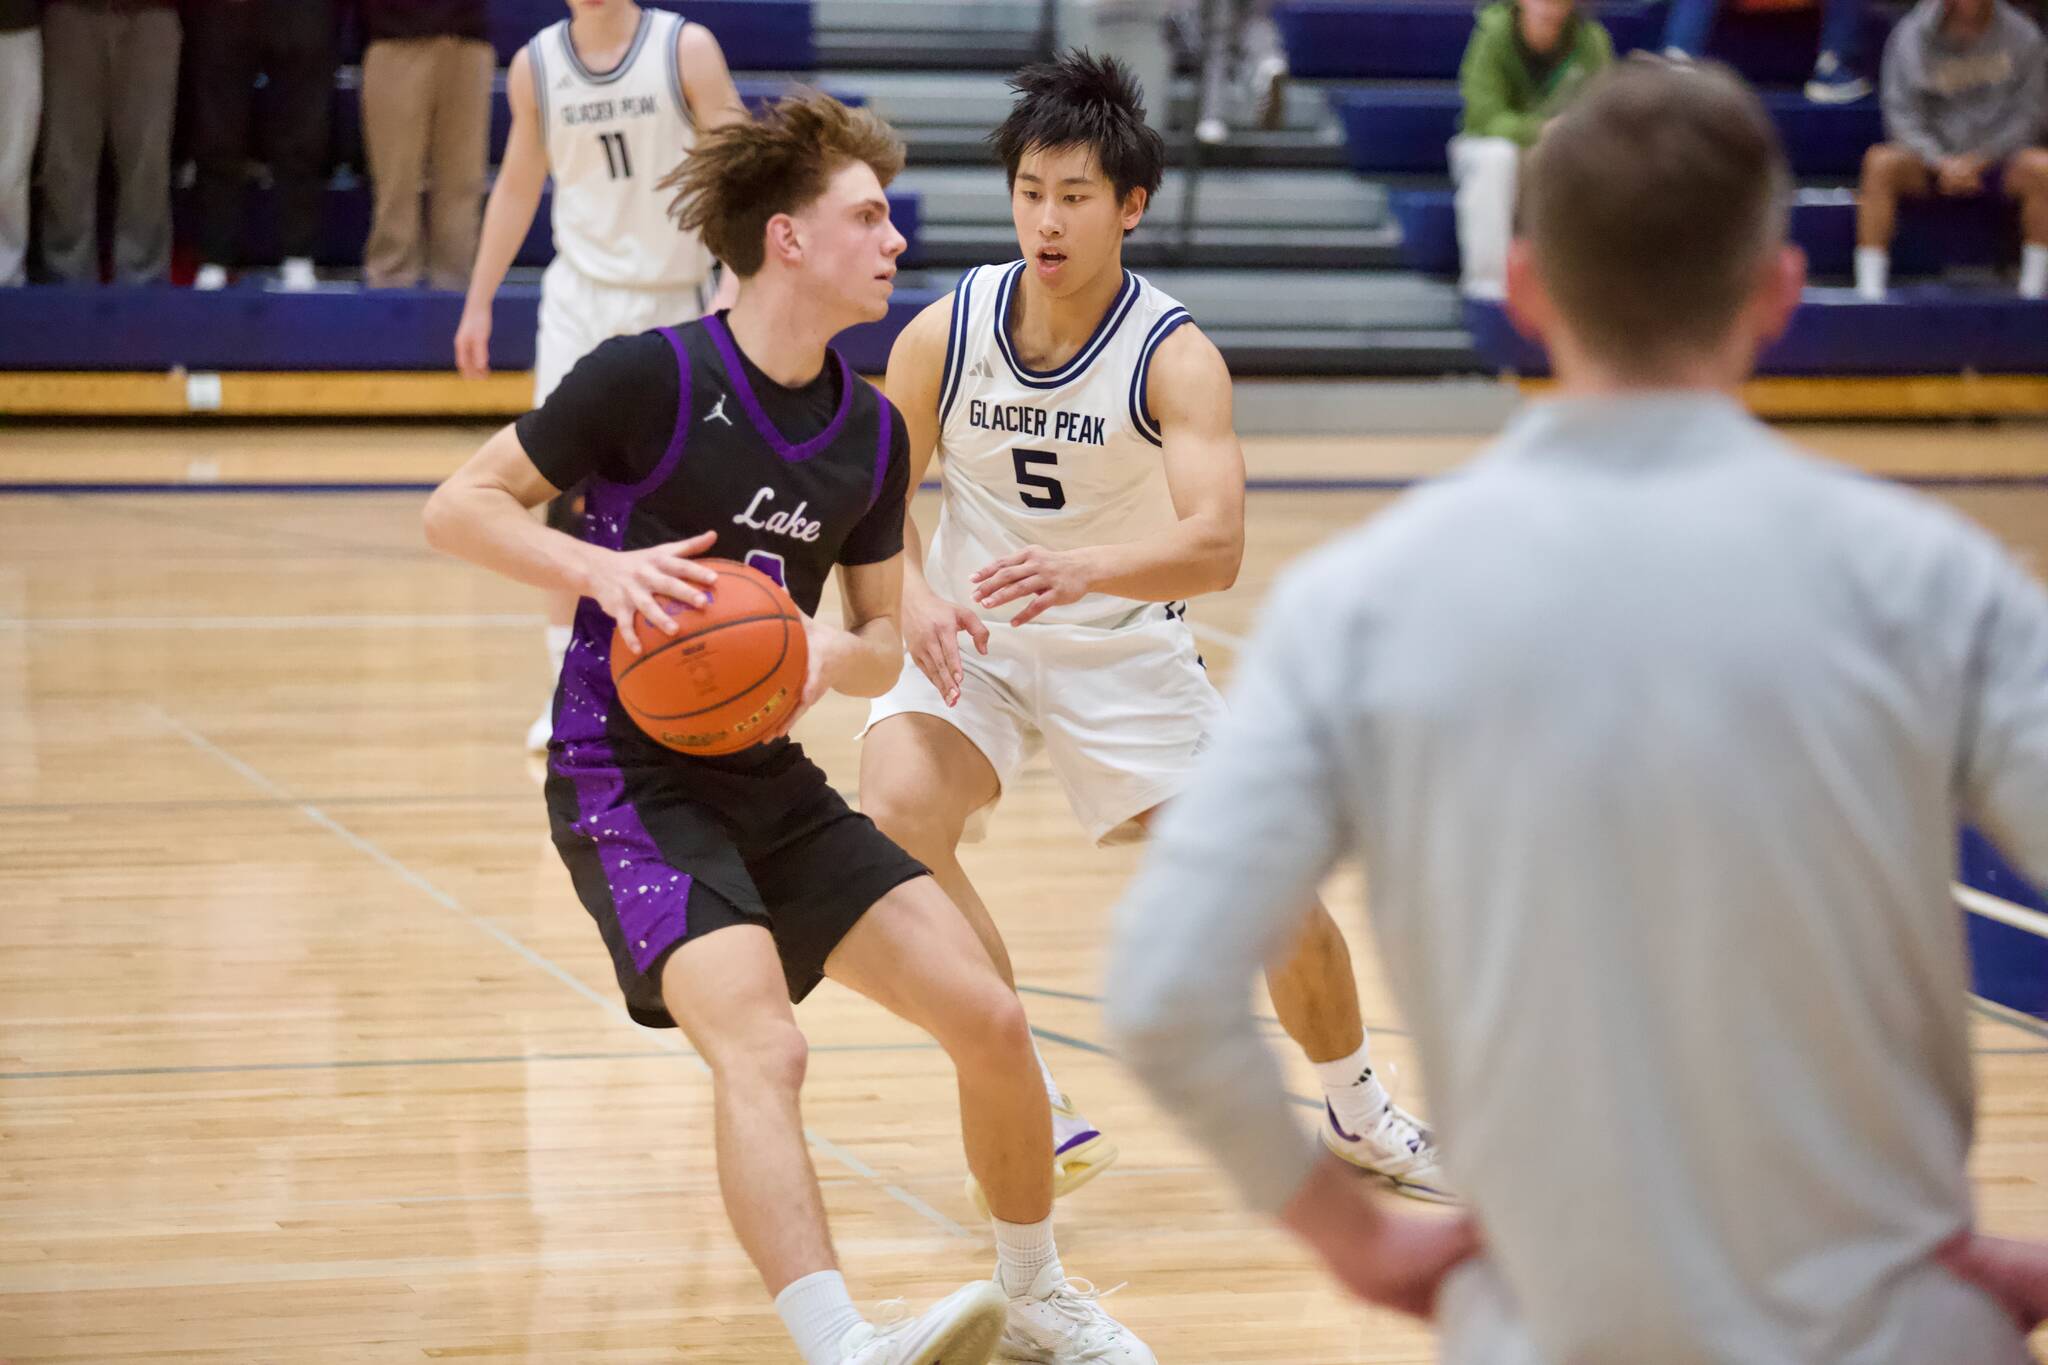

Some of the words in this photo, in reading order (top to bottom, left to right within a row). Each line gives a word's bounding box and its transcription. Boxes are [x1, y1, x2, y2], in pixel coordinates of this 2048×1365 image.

[599, 129, 632, 179] 11
[970, 399, 1047, 437] GLACIER
[1055, 411, 1105, 446] PEAK
[1011, 447, 1066, 510] 5
[732, 486, 821, 542] Lake
